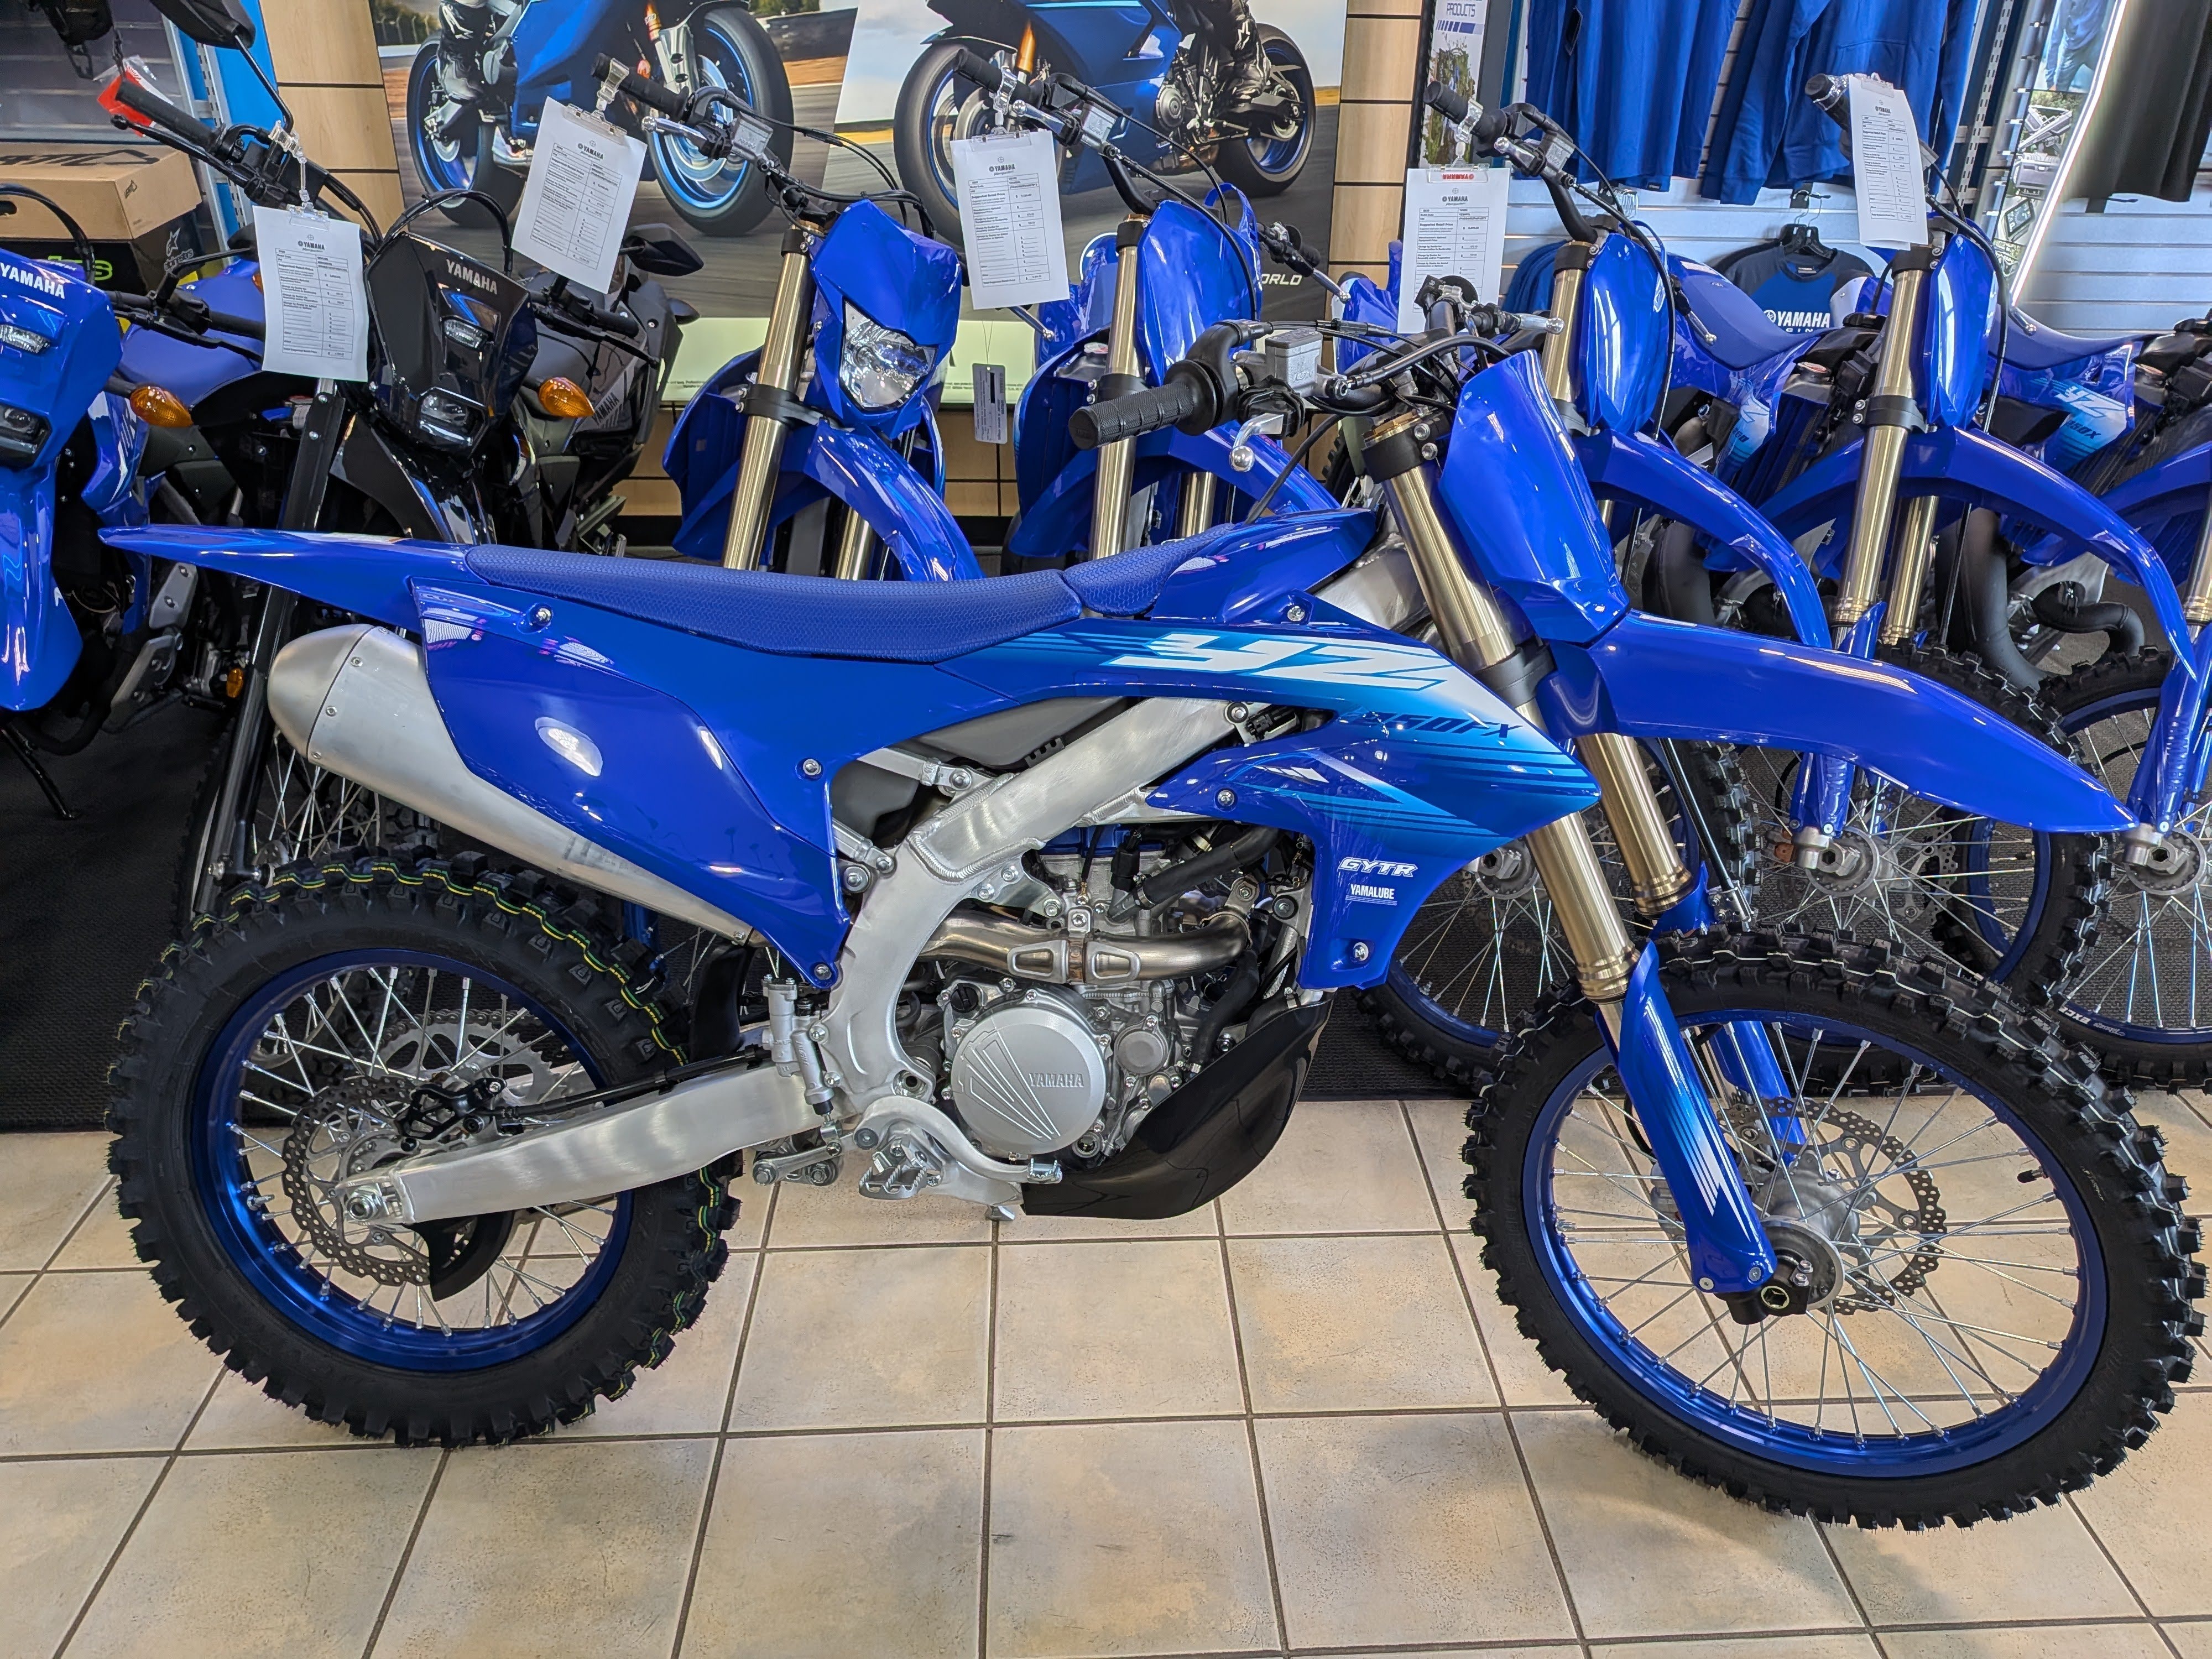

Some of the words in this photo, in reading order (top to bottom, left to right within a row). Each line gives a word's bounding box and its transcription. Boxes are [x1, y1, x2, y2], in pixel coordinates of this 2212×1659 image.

[583, 145, 604, 160] YAMAHA
[304, 241, 325, 251] YAMAHA
[0, 262, 65, 299] YAMAHA
[446, 259, 498, 295] YAMAHA
[1261, 273, 1302, 285] ORLD
[1777, 311, 1830, 328] YAMAHA
[591, 392, 620, 426] YAMAHA
[1105, 632, 1453, 691] YZ
[1353, 711, 1523, 739] 250FX
[1337, 857, 1418, 878] GYTR
[1350, 883, 1395, 900] YAMALUBE
[2058, 1006, 2091, 1025] EXCE
[1029, 1073, 1084, 1088] YAMAHA
